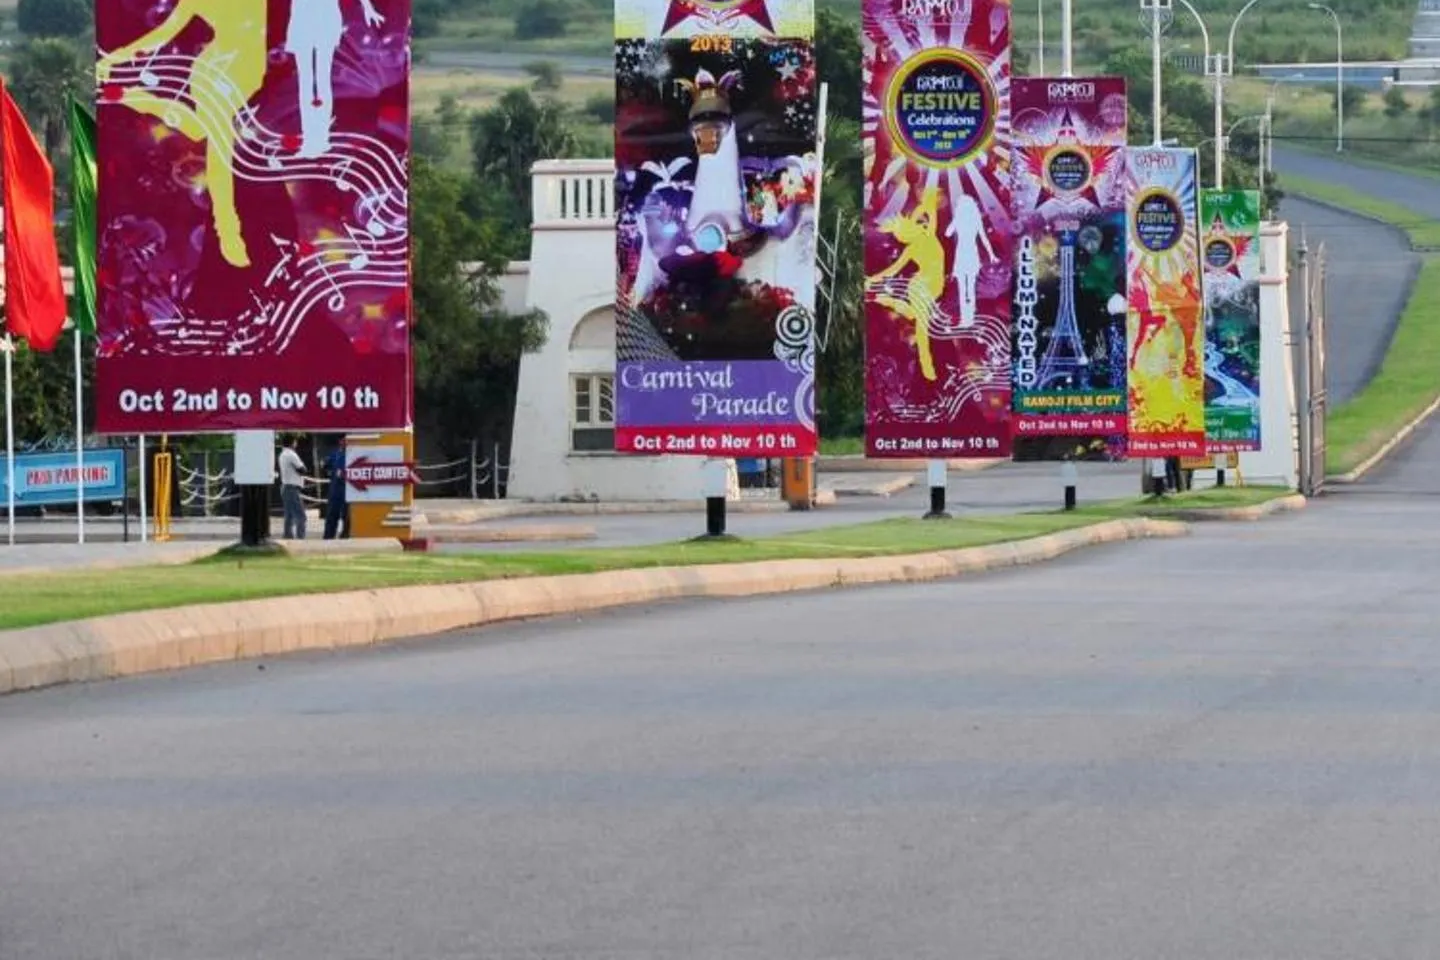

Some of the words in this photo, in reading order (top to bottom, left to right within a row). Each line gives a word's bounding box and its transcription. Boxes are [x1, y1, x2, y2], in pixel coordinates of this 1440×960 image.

[902, 93, 980, 110] FESTIVE
[907, 114, 976, 126] Celebrations
[1019, 236, 1037, 384] ILLUMINATED
[621, 364, 734, 390] Carnival
[118, 388, 165, 412] Oct
[172, 388, 219, 412] 2nd
[226, 390, 252, 411] to
[260, 387, 308, 410] Nov
[316, 386, 346, 409] 10
[354, 386, 380, 409] th
[692, 392, 789, 417] Parade
[1096, 394, 1120, 407] CITY
[634, 434, 662, 450] Oct
[666, 434, 696, 450] 2nd
[701, 435, 715, 449] to
[721, 434, 751, 448] Nov
[756, 433, 774, 448] 10
[780, 433, 796, 448] th
[875, 438, 898, 450] Oct
[900, 437, 922, 450] 2nd
[925, 438, 939, 449] to
[942, 437, 965, 449] Nov
[968, 437, 984, 449] 10
[986, 437, 999, 449] th
[345, 467, 372, 481] TICKET
